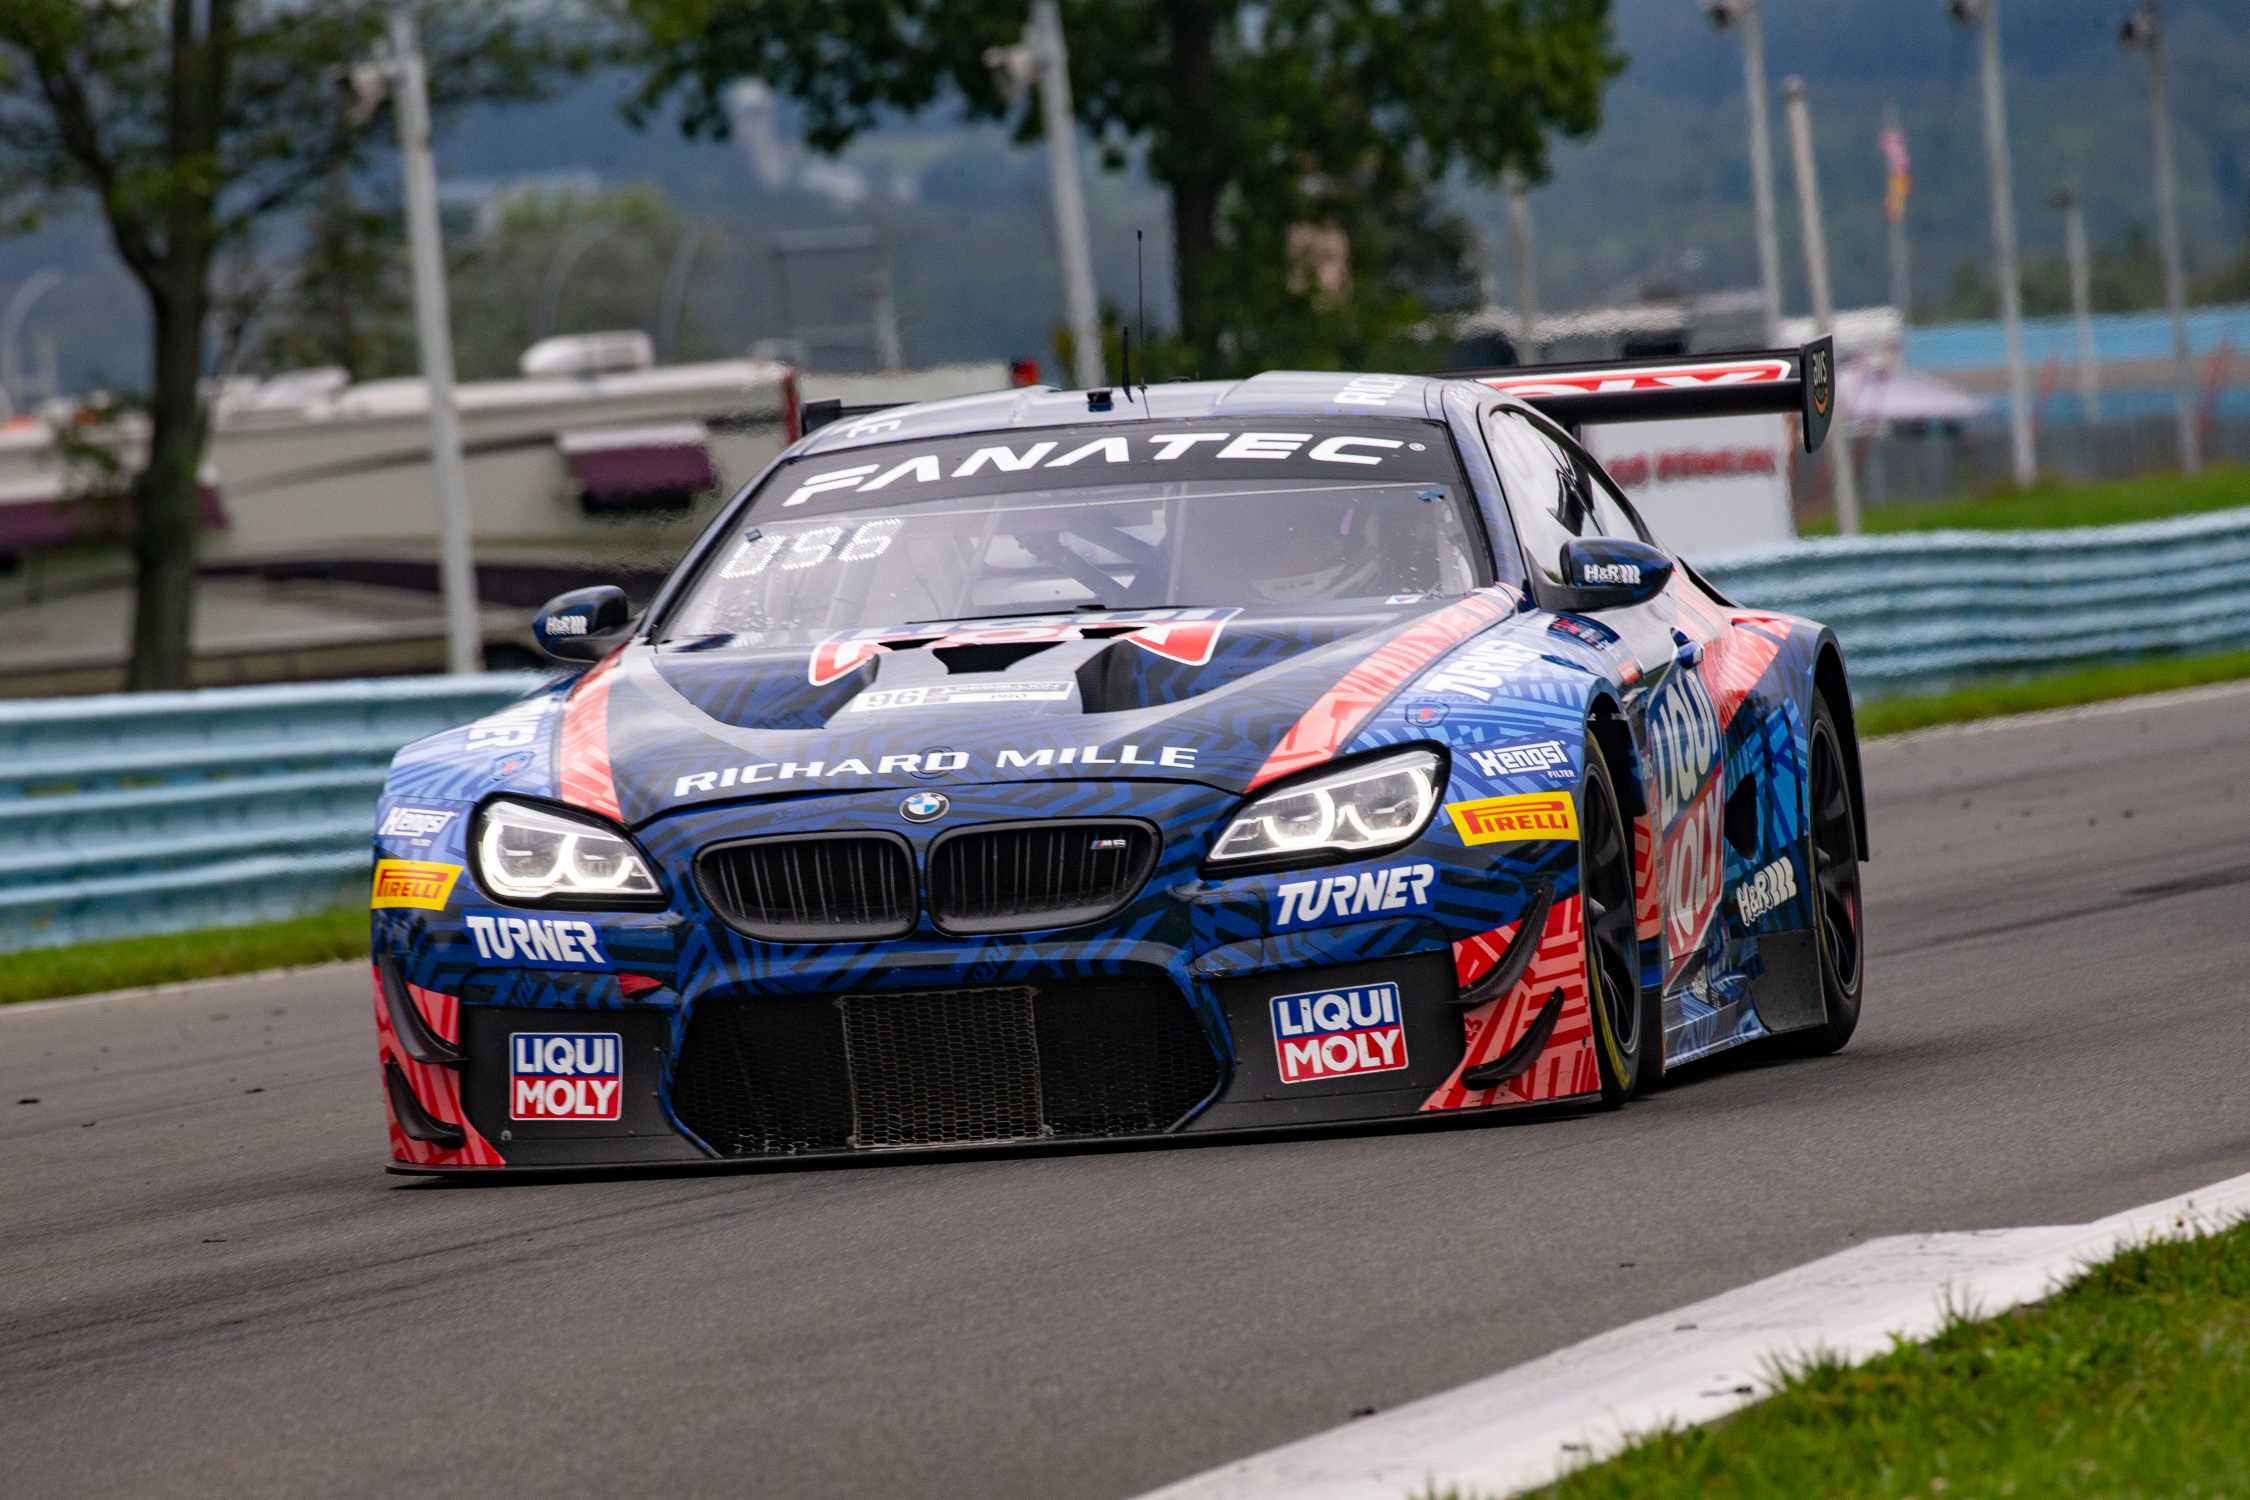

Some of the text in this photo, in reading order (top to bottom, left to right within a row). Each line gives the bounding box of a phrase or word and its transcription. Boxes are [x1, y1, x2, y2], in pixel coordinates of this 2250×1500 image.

[673, 744, 1199, 797] RICHARD MILLE
[1472, 740, 1569, 777] Hengst
[1652, 668, 1719, 832] LIQUI
[1462, 800, 1569, 834] PIRELLI
[376, 868, 448, 899] PIRELLI
[1275, 863, 1437, 926] TURNER
[466, 915, 607, 963] TURNER
[1276, 988, 1396, 1036] LIQUI
[516, 1037, 617, 1076] LIQUI
[1283, 1029, 1401, 1077] MOLY
[515, 1080, 619, 1116] MOLY
